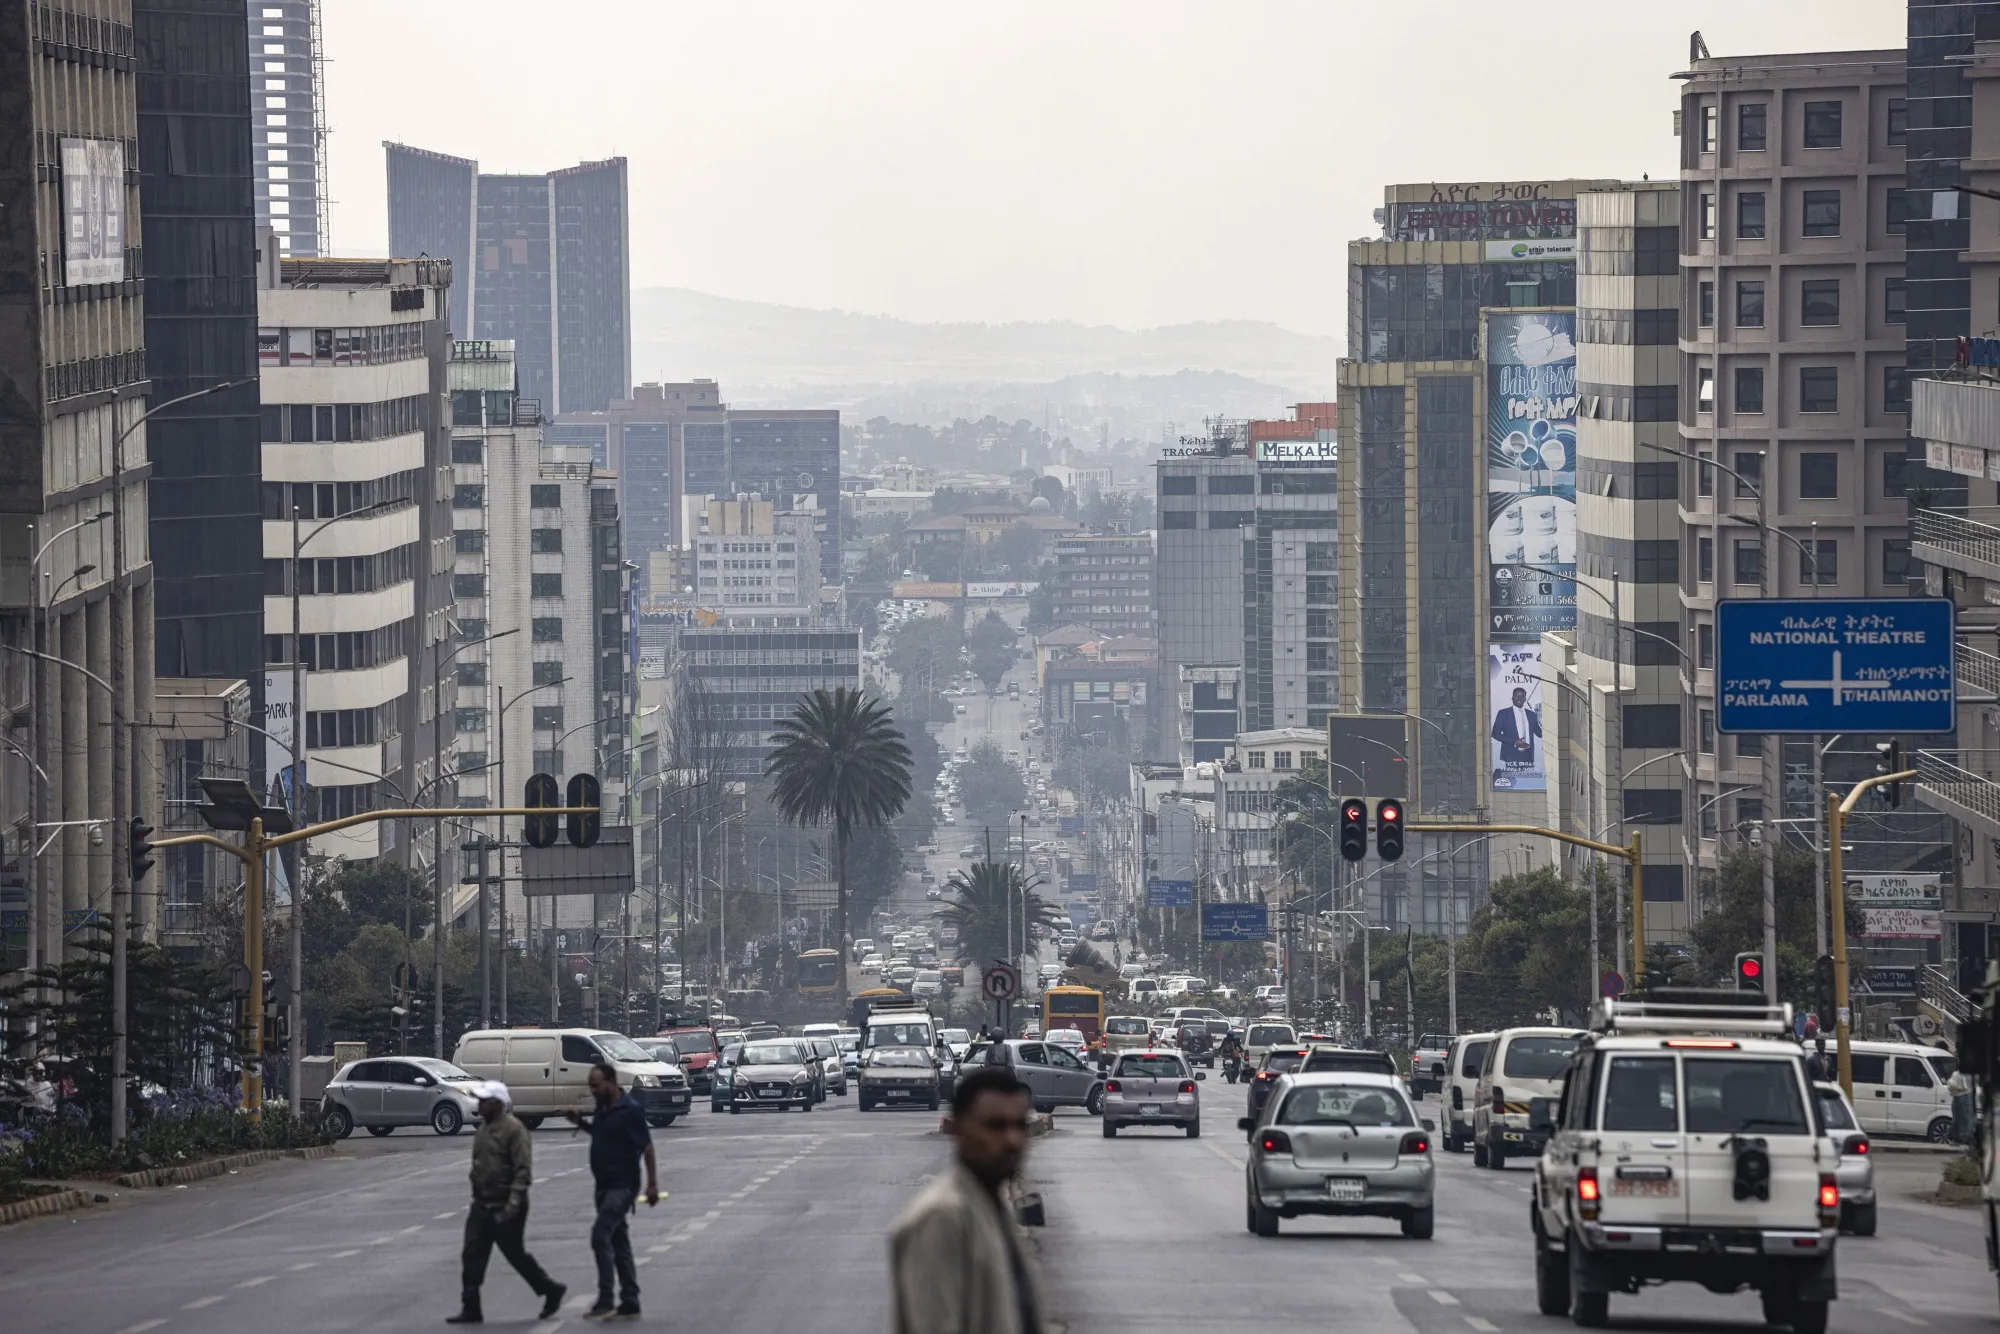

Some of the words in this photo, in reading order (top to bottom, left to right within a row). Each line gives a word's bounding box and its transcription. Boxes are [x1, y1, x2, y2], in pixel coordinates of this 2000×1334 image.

[1263, 442, 1314, 456] MELKA
[1515, 595, 1537, 605] +251
[1780, 616, 1837, 630] ብሔራዊ
[1750, 632, 1839, 644] NATIONAL
[1844, 632, 1926, 644] THEATRE
[1504, 675, 1533, 684] PALM
[1724, 693, 1809, 707] PARLAMA
[1842, 688, 1950, 702] T/HAIMANOT
[1896, 980, 1912, 988] Bank
